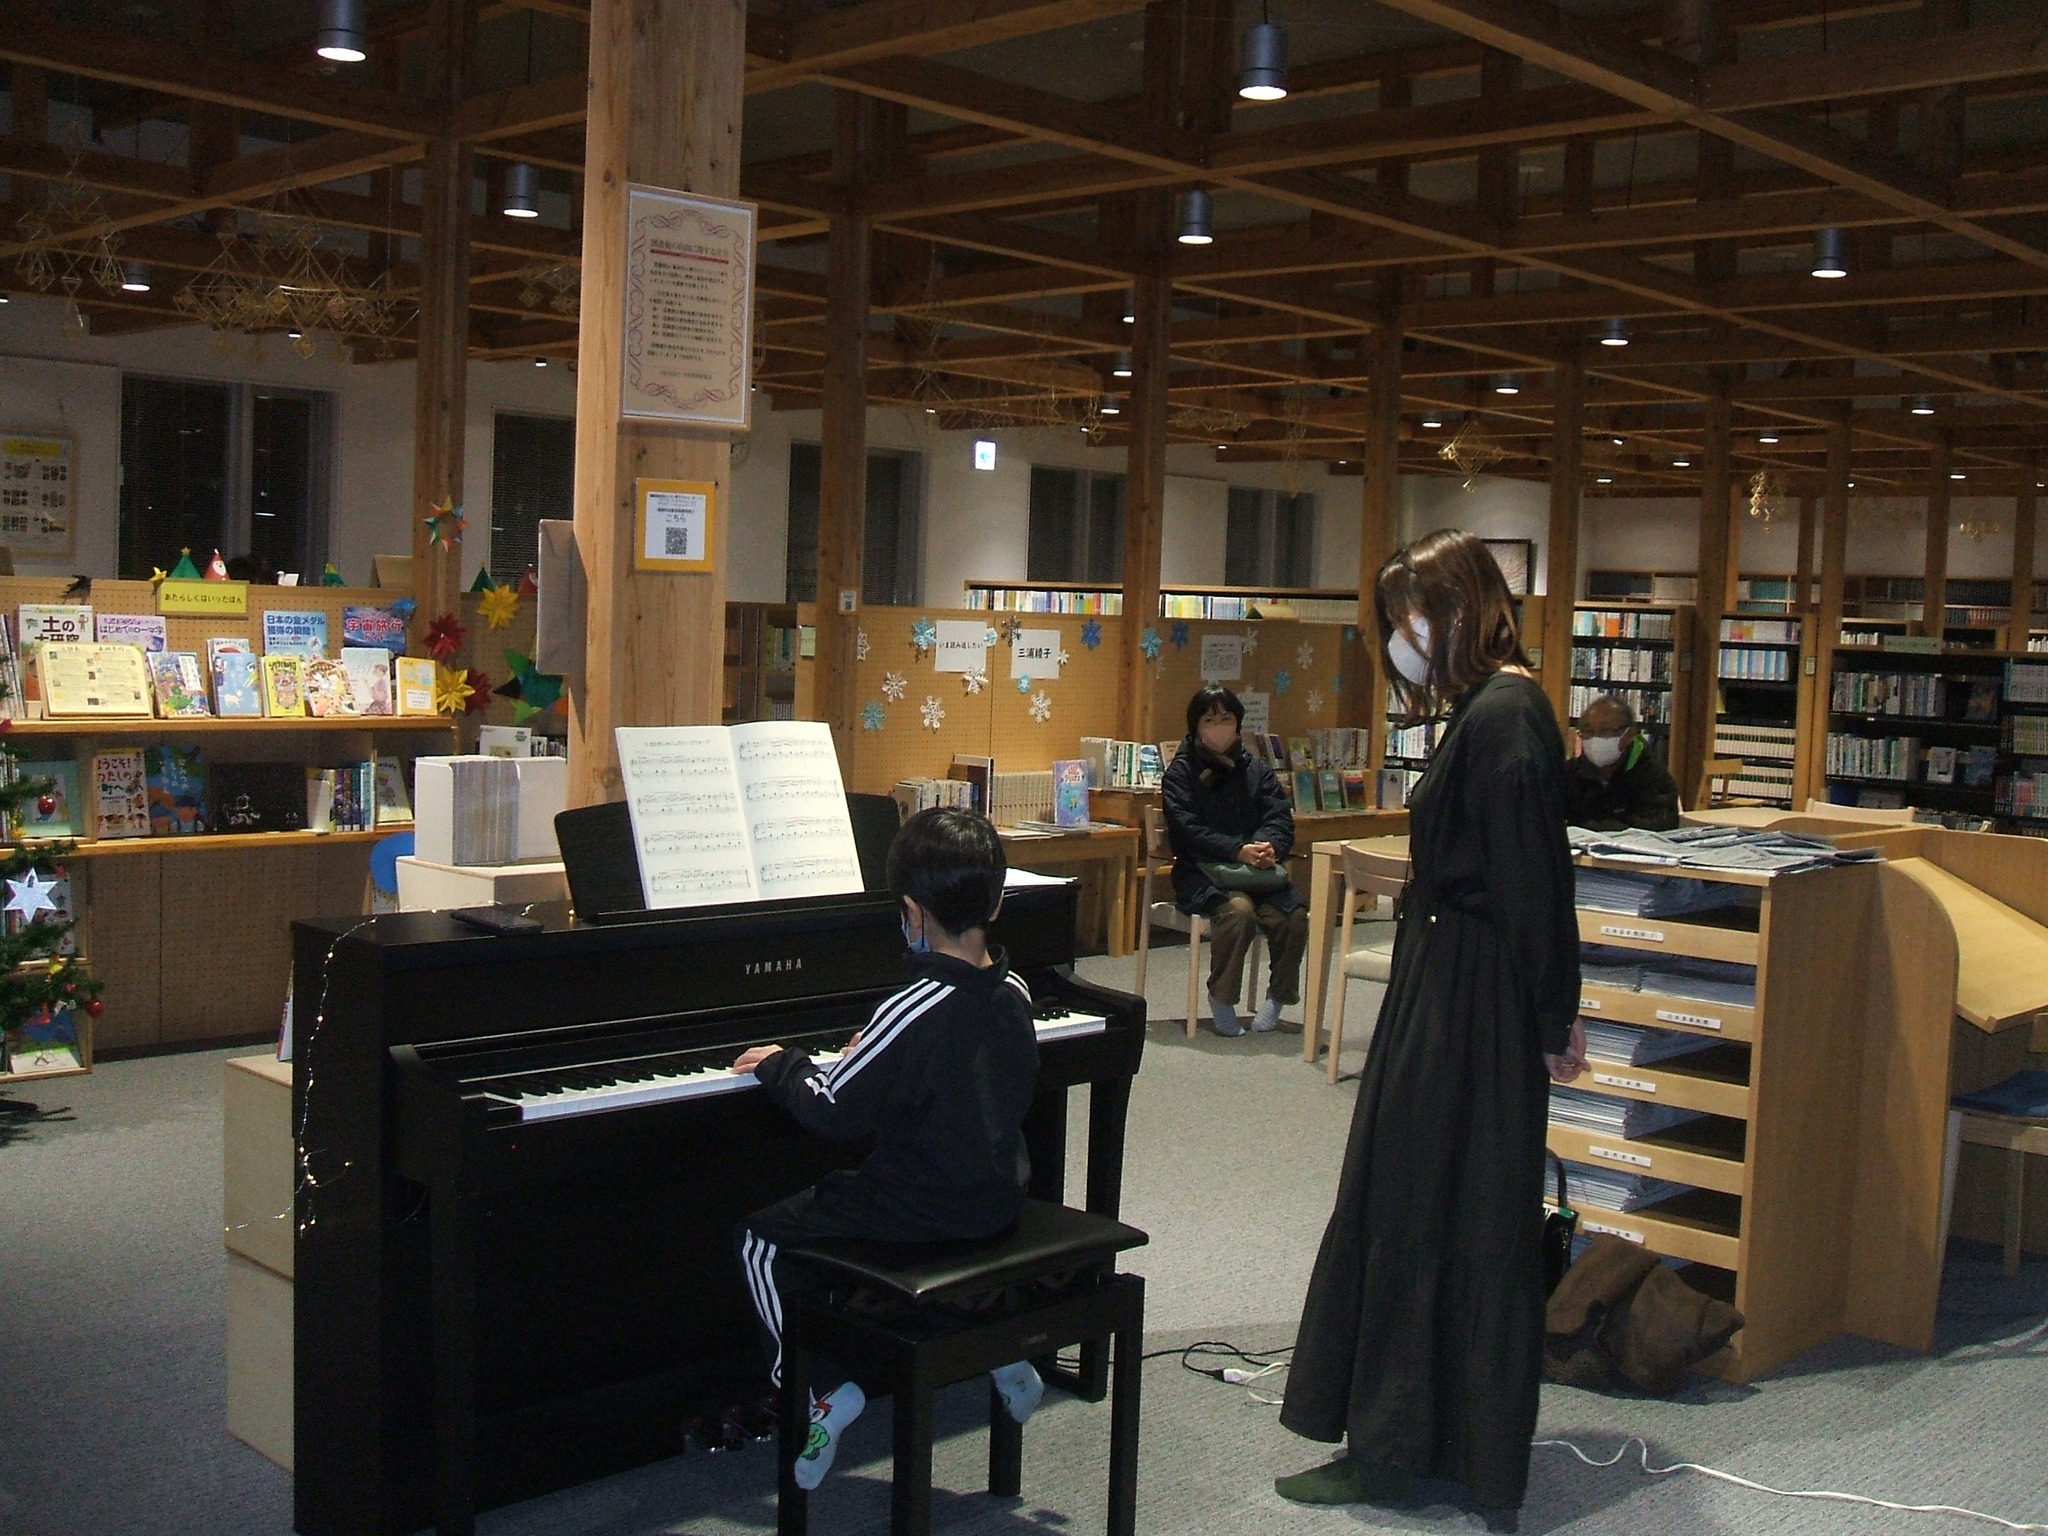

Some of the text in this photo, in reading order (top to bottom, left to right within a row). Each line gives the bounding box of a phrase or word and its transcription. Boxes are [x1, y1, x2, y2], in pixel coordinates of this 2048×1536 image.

[42, 615, 75, 633] 土の
[267, 615, 325, 625] 日本の金メダル
[346, 618, 403, 632] 宇宙旅行
[1017, 647, 1052, 659] 三浦綾子
[745, 958, 802, 975] YAMAHA
